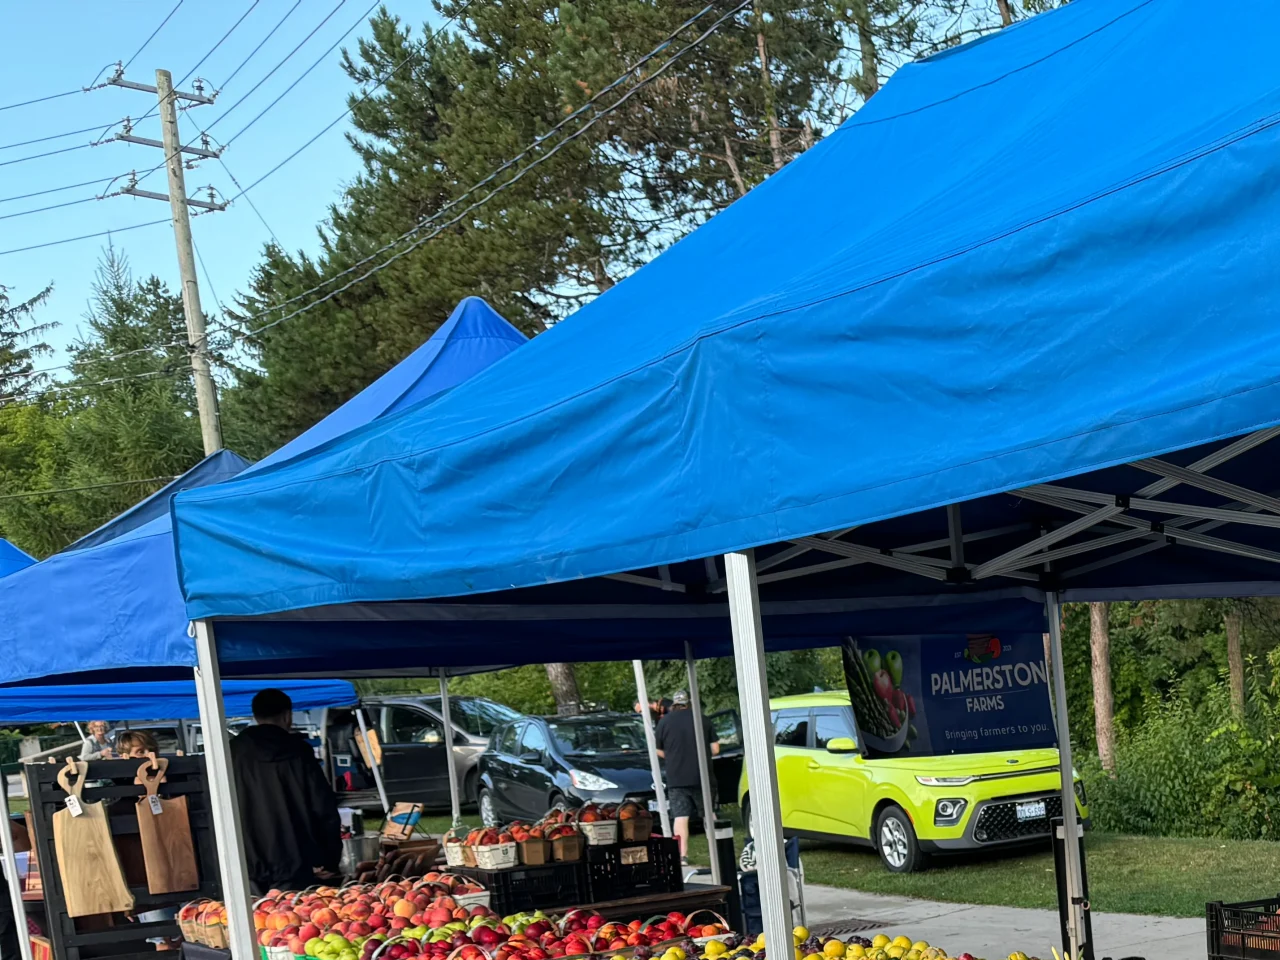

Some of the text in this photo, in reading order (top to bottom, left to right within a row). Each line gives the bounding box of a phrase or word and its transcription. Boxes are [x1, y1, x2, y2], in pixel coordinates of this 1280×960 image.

[931, 660, 1047, 695] PALMERSTON
[966, 695, 1005, 712] FARMS
[945, 723, 1049, 740] Bringing farmers to you.
